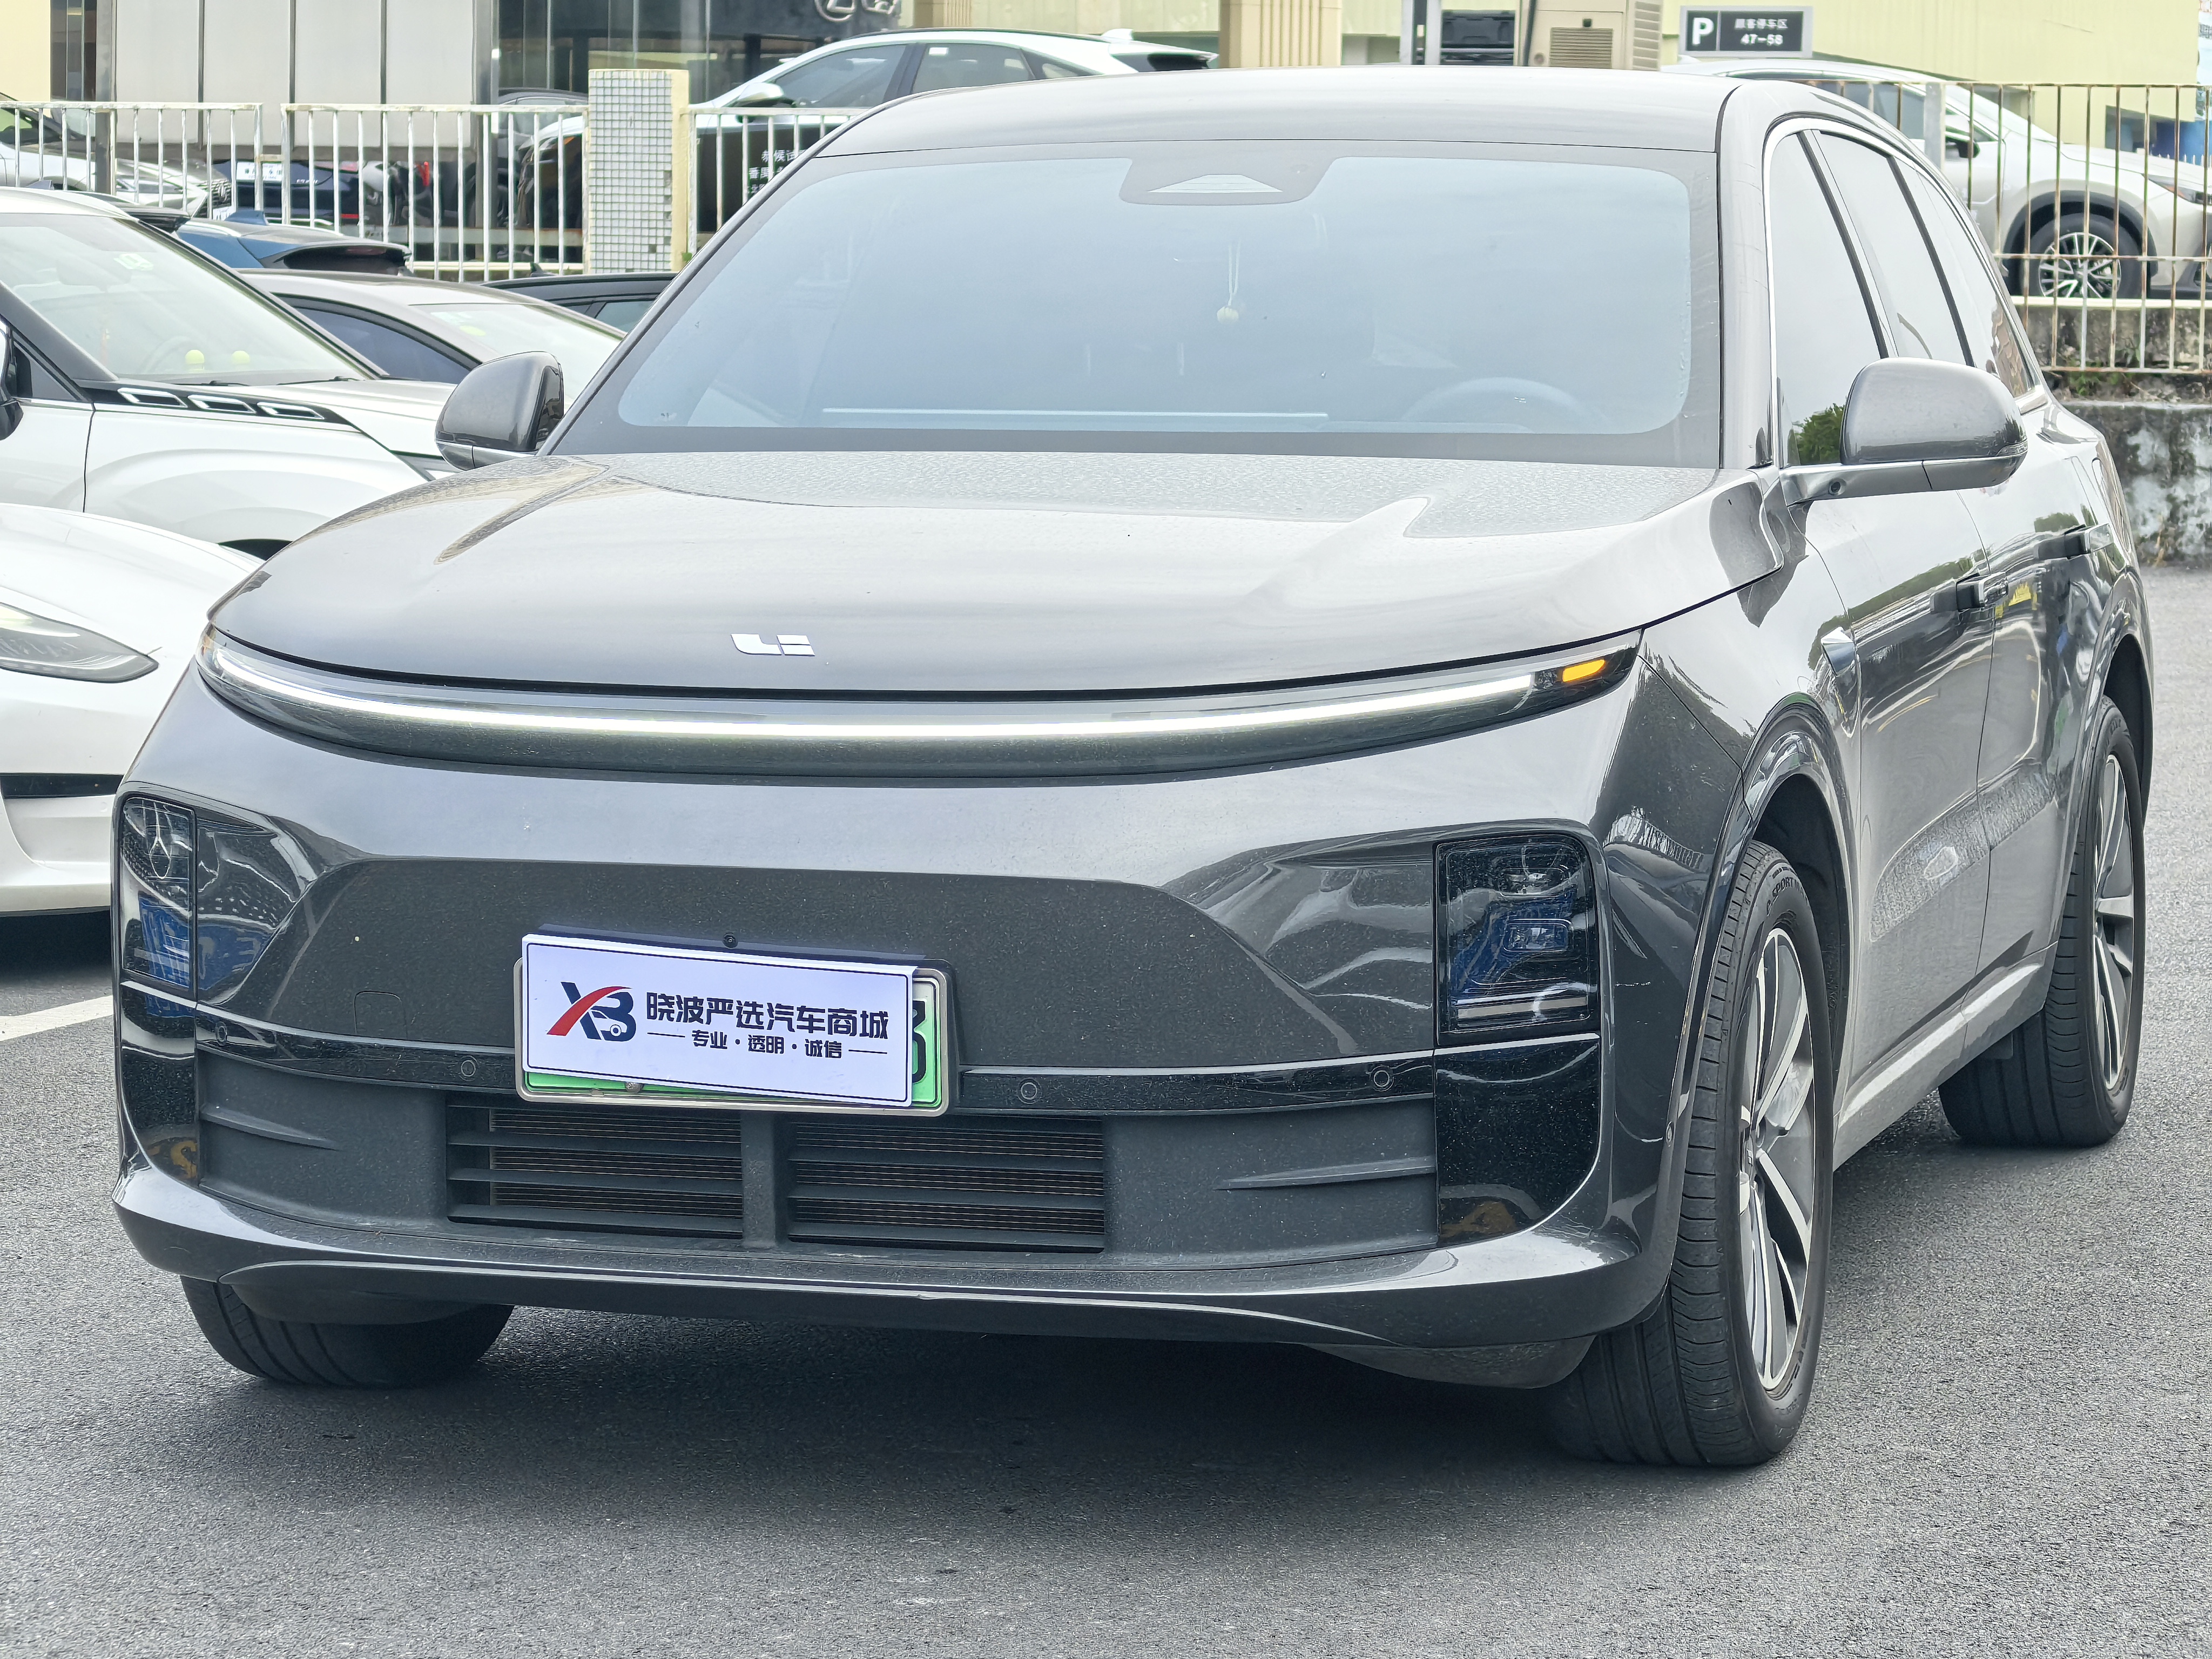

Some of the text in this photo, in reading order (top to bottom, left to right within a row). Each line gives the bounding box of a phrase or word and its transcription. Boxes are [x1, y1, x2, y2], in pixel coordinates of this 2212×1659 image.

[1692, 17, 1714, 45] P
[646, 992, 888, 1039] 晓波严选汽车商城
